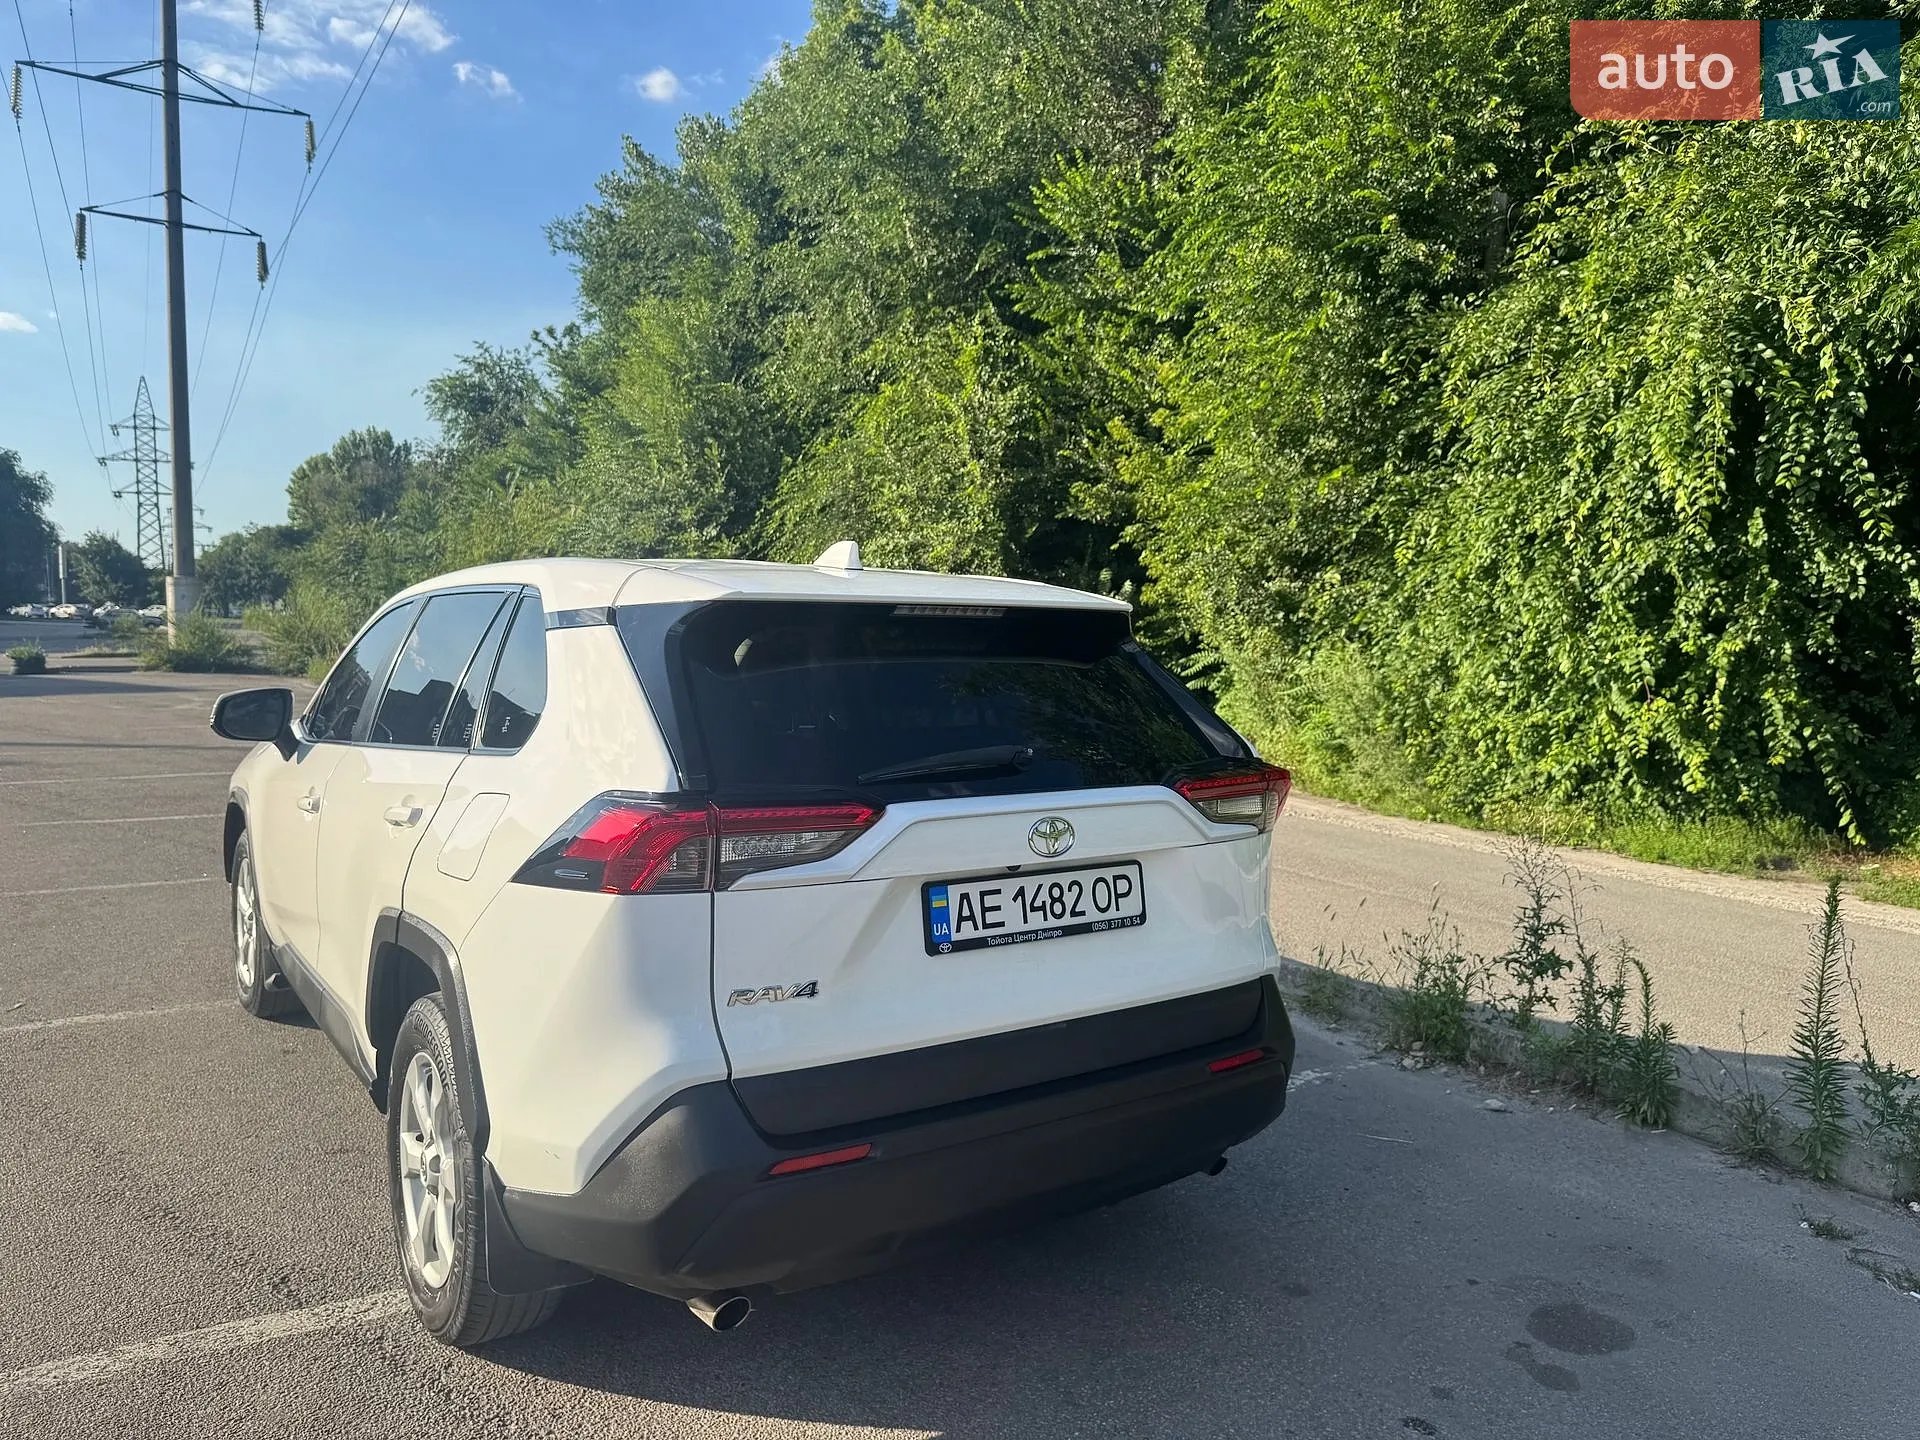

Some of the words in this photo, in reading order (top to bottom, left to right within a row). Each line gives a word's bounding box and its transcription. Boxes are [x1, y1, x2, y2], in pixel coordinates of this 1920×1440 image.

[955, 888, 1006, 934] AE
[1012, 880, 1087, 924] 1482
[1091, 873, 1133, 914] OP
[933, 923, 950, 936] UA
[1091, 921, 1109, 931] (056)
[1110, 919, 1122, 928] 377
[1123, 918, 1131, 927] 10
[987, 936, 1013, 946] Тойота
[1013, 932, 1036, 943] Центр
[1037, 929, 1063, 940] Дніпро
[727, 980, 819, 1007] RAV4
